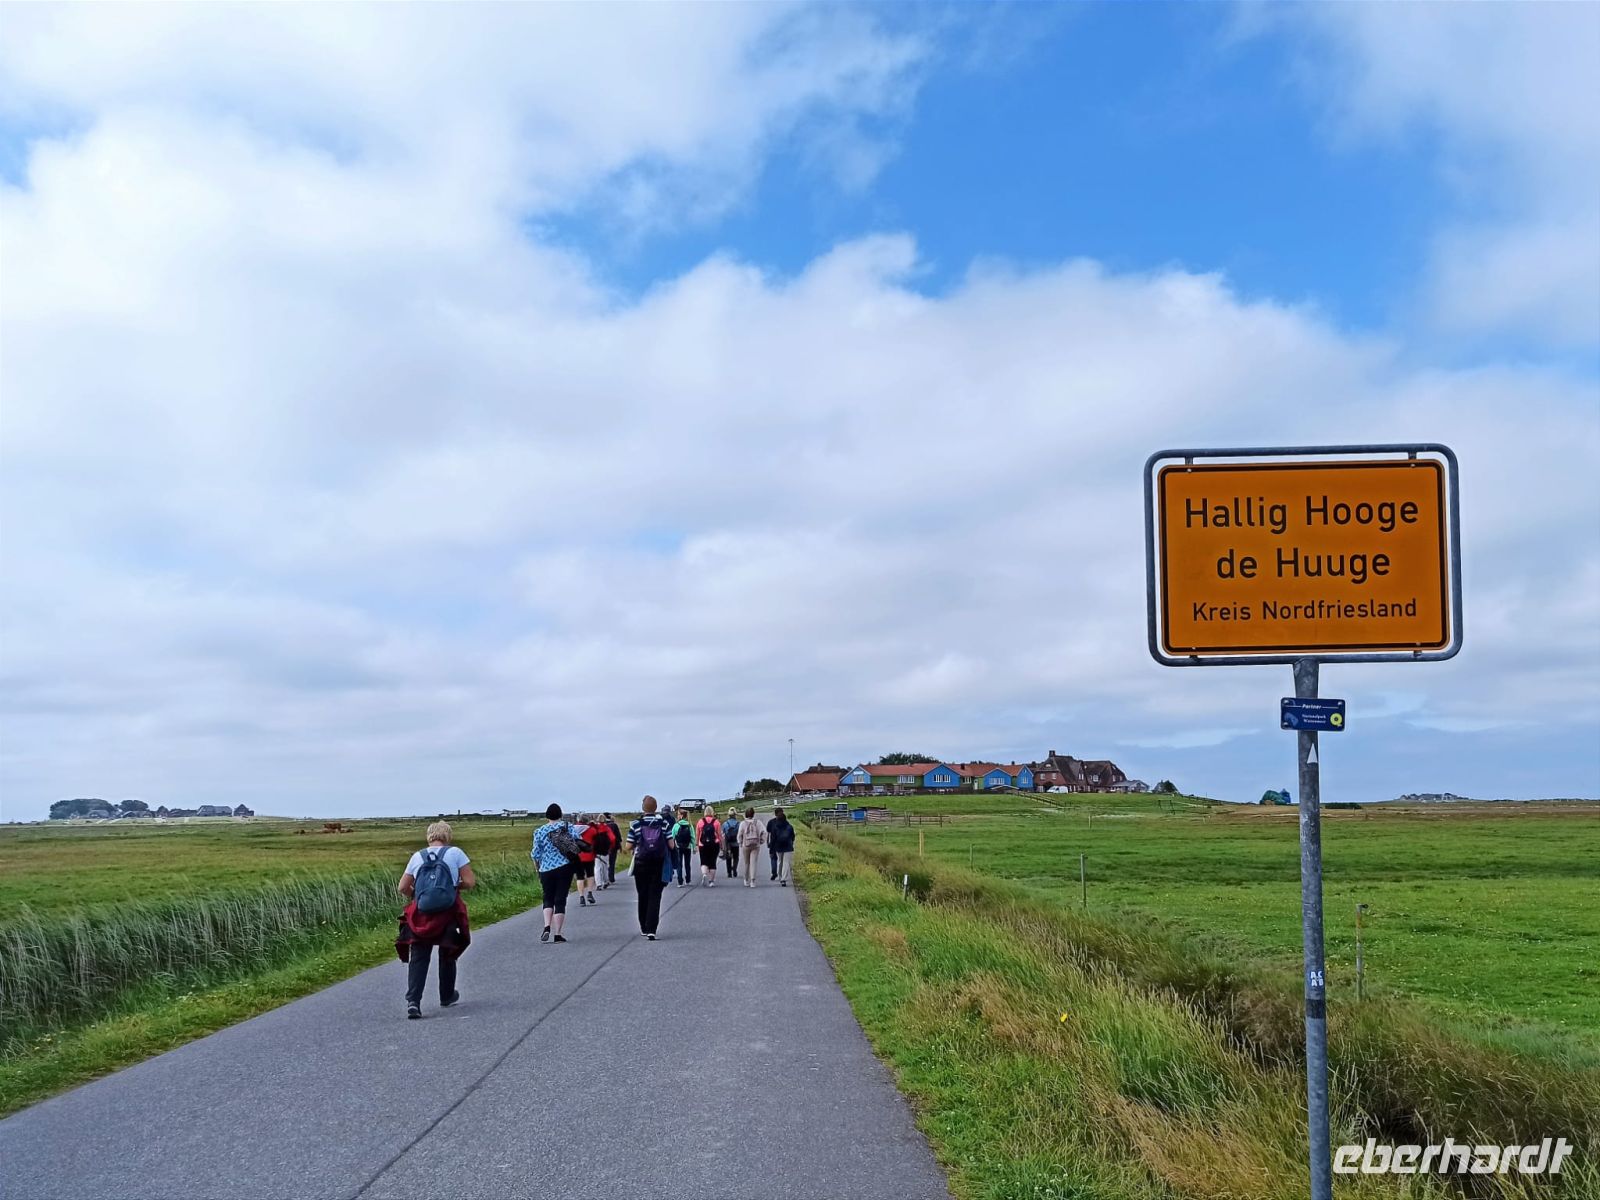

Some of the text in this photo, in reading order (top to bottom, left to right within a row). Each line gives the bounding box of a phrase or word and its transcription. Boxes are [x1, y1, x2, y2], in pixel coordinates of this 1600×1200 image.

[1185, 495, 1418, 534] Hallig Hooge
[1217, 547, 1391, 584] de Huuge
[1193, 598, 1417, 621] Kreis Nordfriesland
